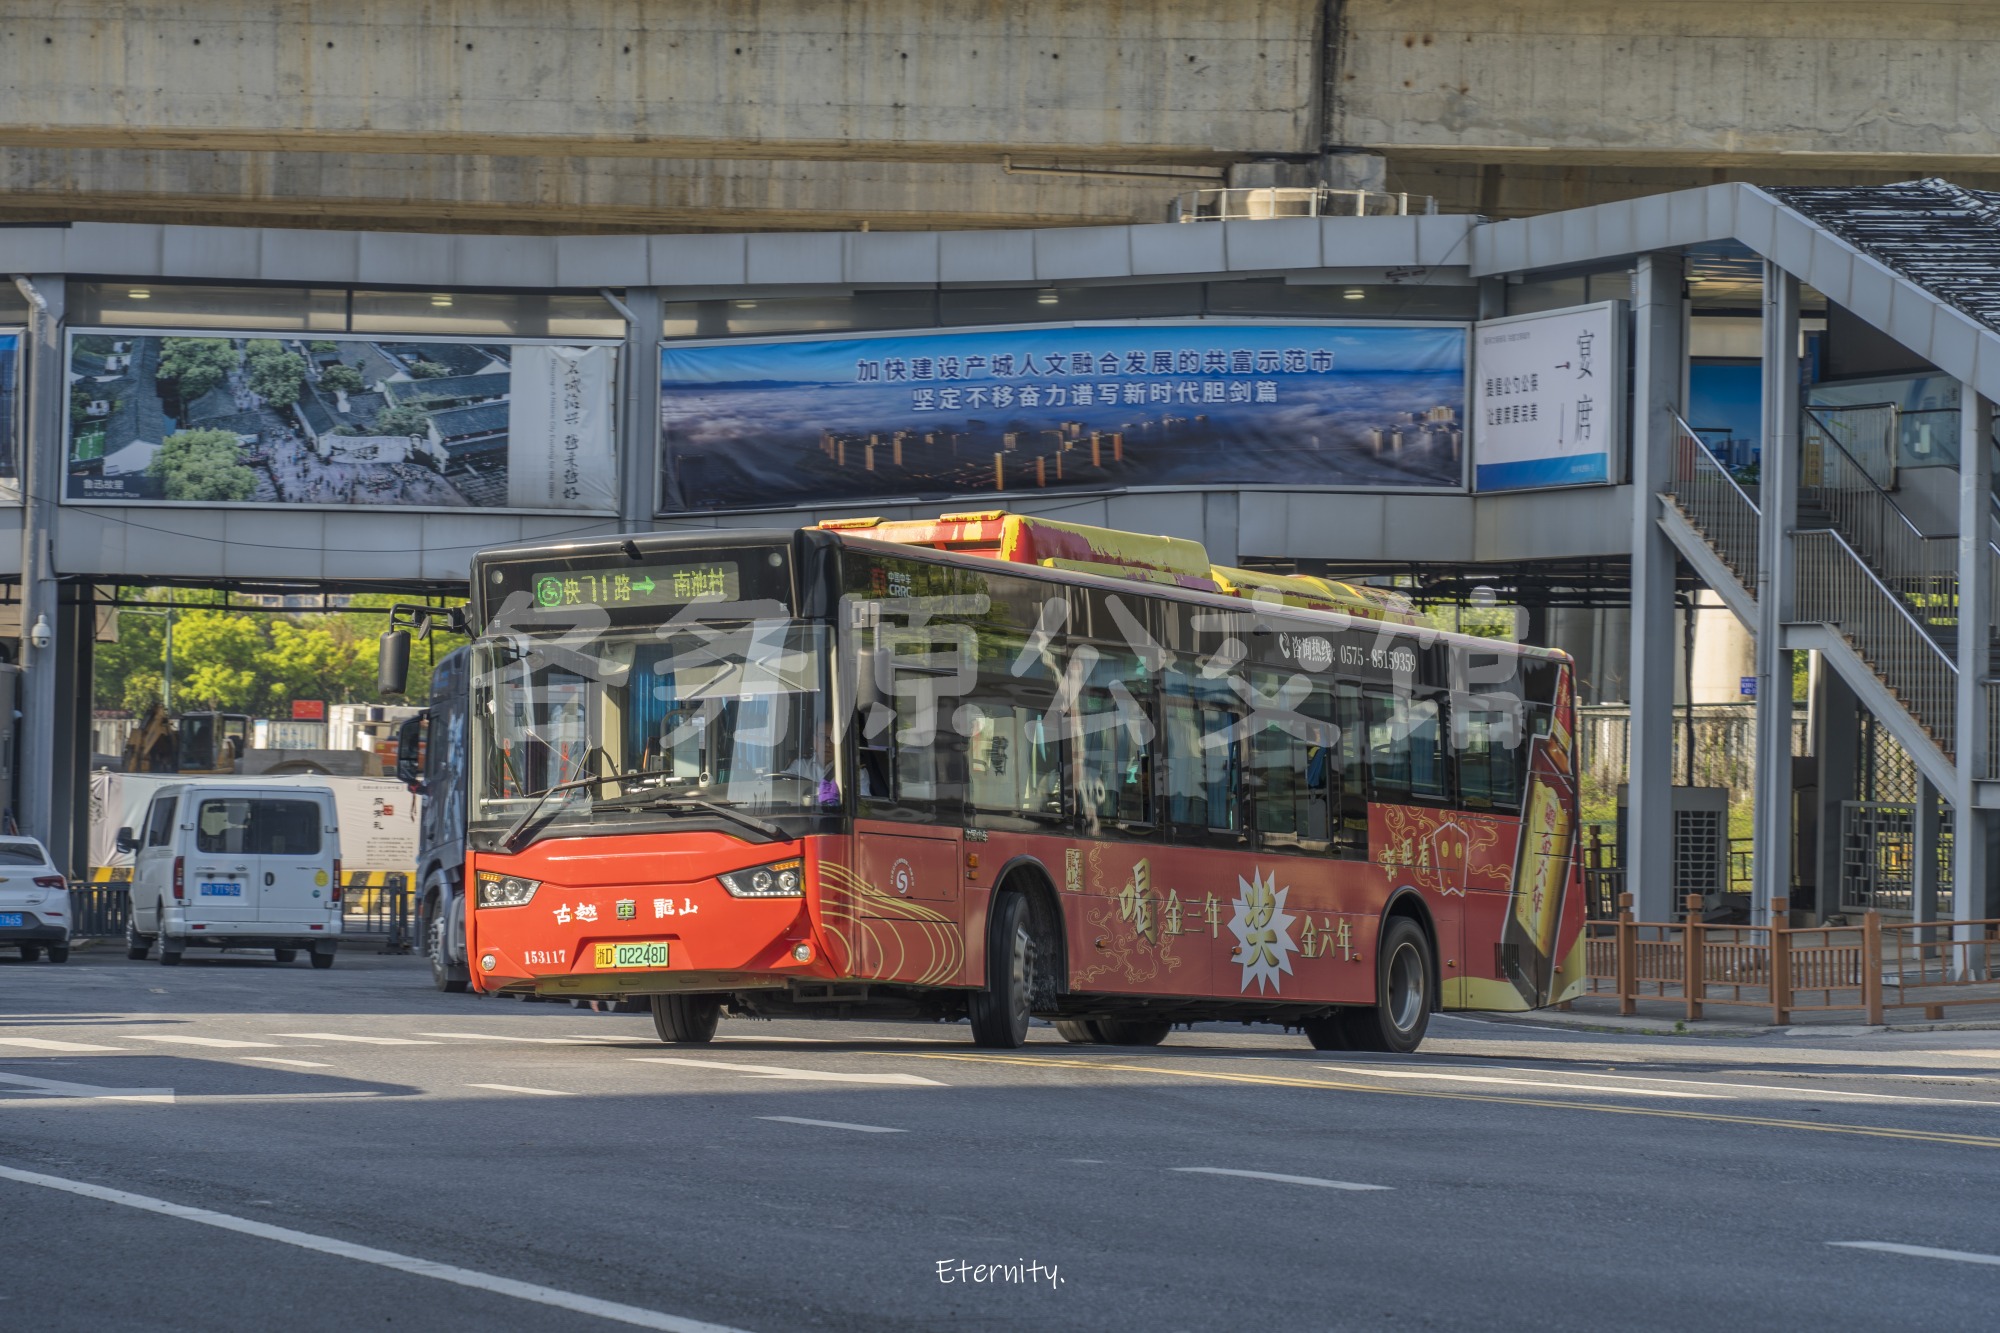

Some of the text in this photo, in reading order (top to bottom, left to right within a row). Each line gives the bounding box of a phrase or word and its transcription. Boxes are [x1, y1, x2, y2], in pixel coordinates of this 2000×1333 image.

[856, 348, 1335, 383] 加快建设产城人文融合发展的共富示范市
[911, 380, 1279, 411] 坚定不移奋力谱写新时代胆剑篇
[887, 571, 912, 584] 中国中车
[888, 583, 912, 598] CRRC
[523, 949, 567, 965] 153117
